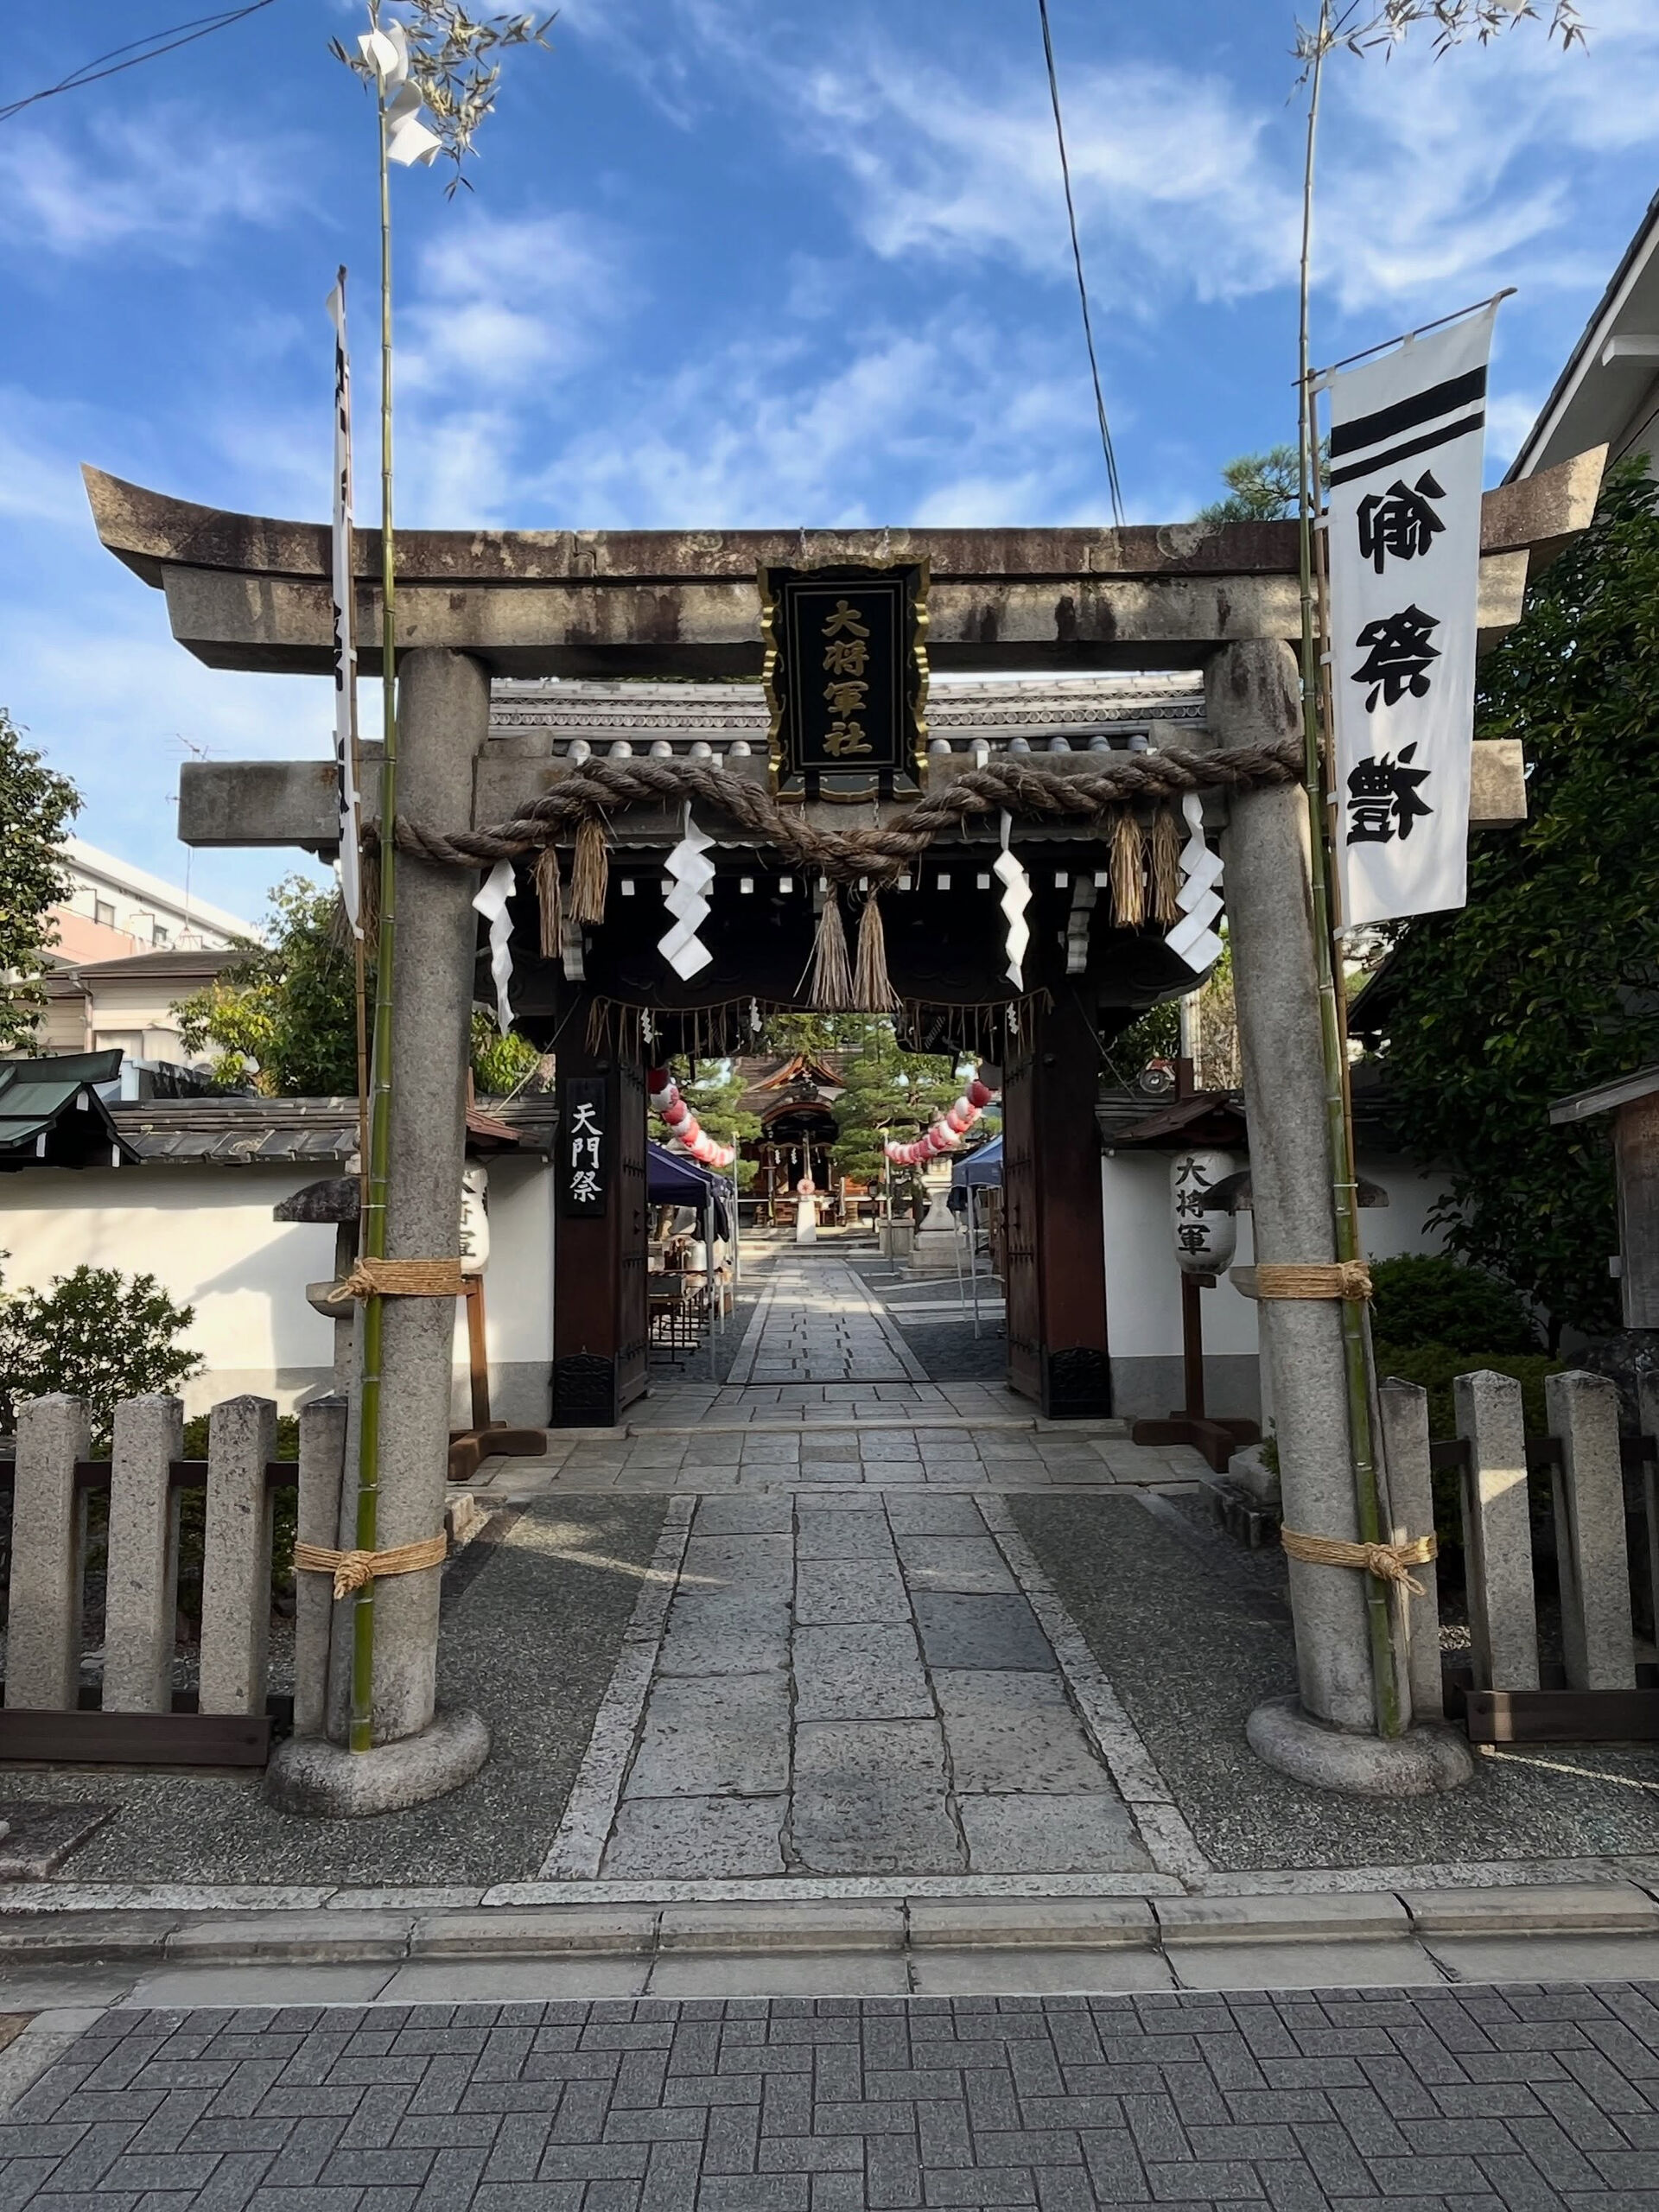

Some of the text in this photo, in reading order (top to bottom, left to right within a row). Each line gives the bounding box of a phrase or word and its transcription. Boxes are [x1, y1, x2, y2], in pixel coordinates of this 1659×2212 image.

[821, 600, 873, 757] 大将軍社
[569, 1103, 603, 1203] 天門祭
